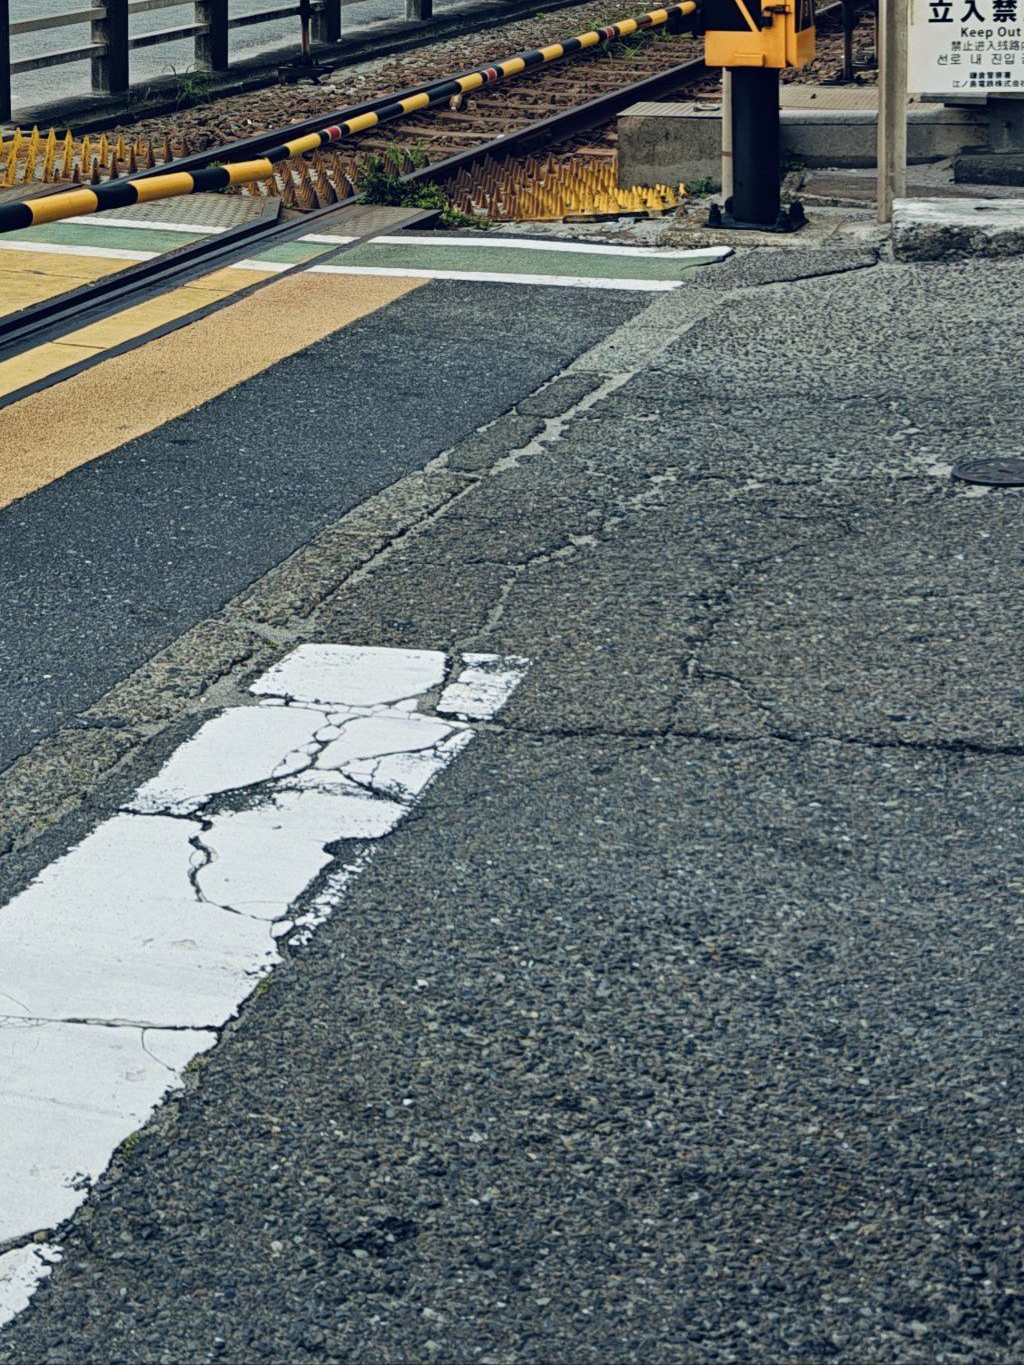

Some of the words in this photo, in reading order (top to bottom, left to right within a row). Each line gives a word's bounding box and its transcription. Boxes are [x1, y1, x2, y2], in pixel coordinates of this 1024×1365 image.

[960, 27, 993, 39] Keep
[997, 27, 1021, 37] Out
[937, 54, 962, 65] 선로
[970, 54, 982, 64] 내
[991, 54, 1015, 65] 진입
